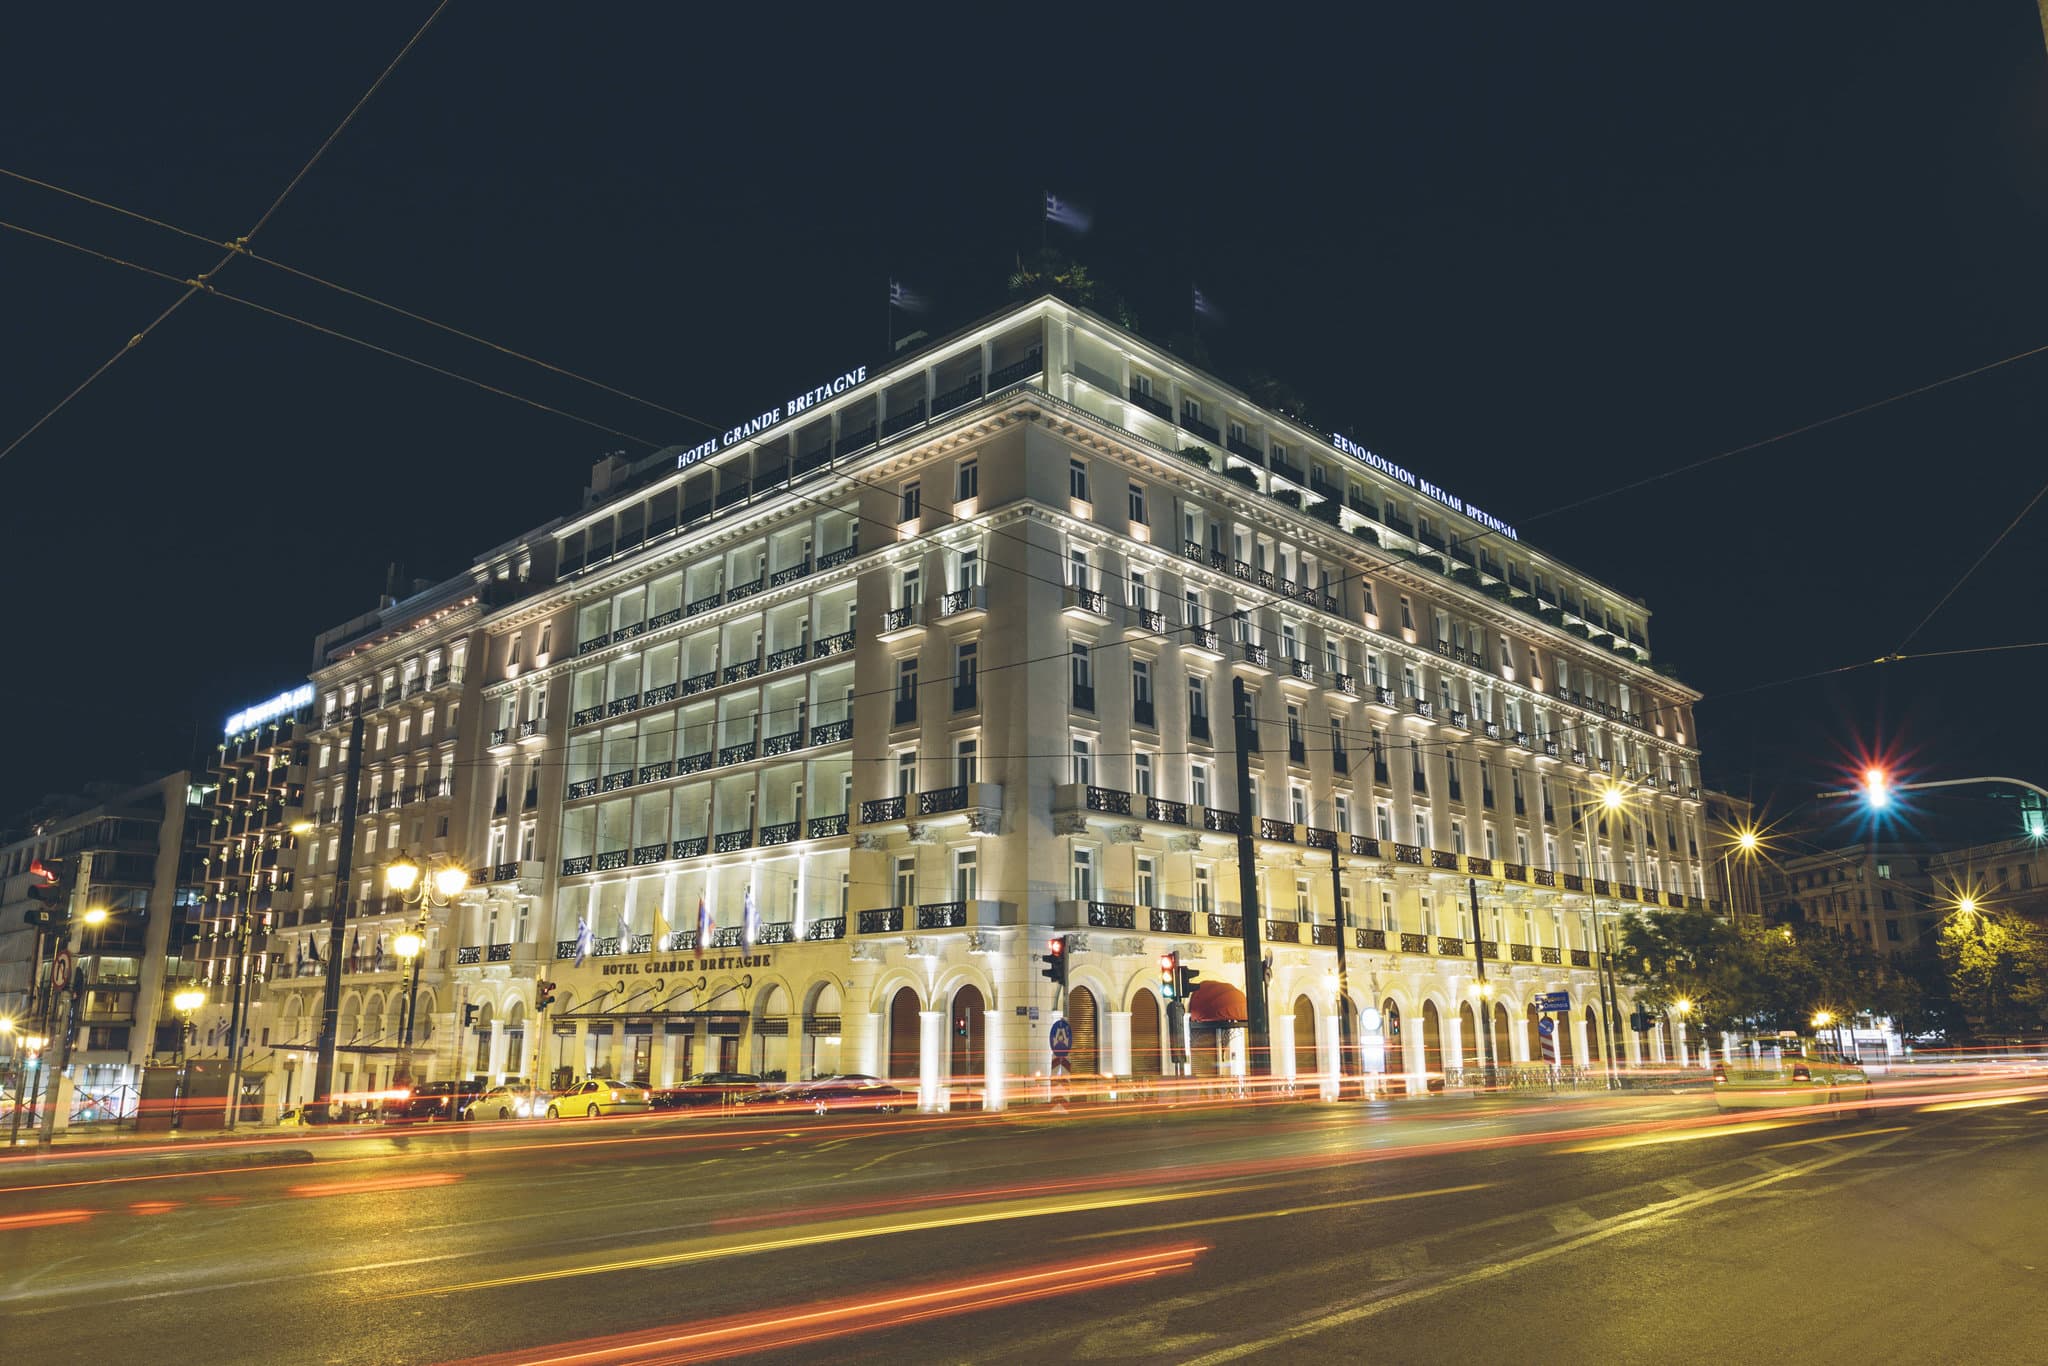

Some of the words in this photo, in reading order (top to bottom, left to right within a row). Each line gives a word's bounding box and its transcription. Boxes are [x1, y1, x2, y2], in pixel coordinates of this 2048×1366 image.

[677, 438, 718, 469] HOTEL
[723, 407, 780, 446] GRANDE
[787, 366, 867, 417] BRETAGNE
[1333, 432, 1416, 487] ΞΕΝΟΔΟΧΕΙΟΝ
[1420, 478, 1462, 512] ΜΕΓΑΛΗ
[602, 963, 639, 976] HOTEL
[644, 959, 694, 974] GRANDE
[699, 954, 771, 971] BRETAGNE
